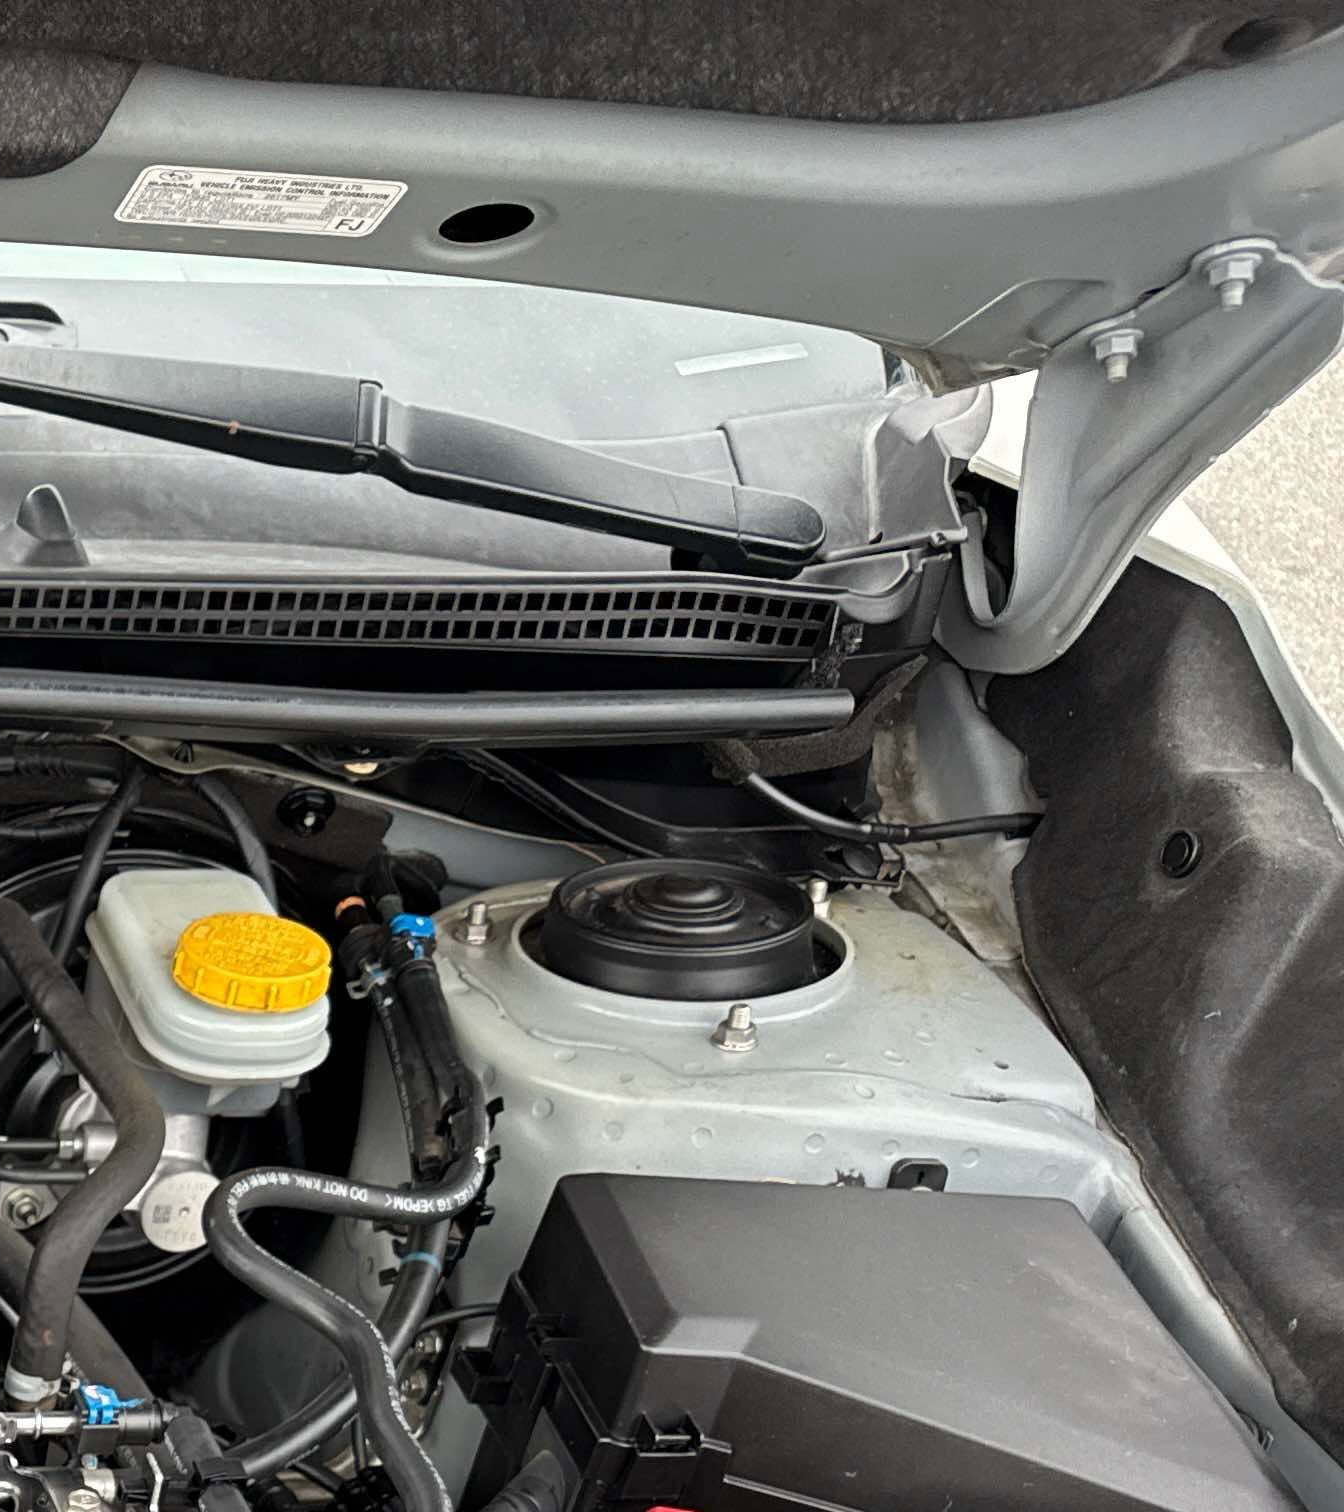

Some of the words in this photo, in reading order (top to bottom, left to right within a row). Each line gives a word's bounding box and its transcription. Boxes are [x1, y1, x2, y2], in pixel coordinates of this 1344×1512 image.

[235, 176, 256, 184] FUJI
[257, 177, 287, 186] HEAVY
[290, 180, 343, 190] INDUSTRIES
[201, 182, 236, 190] VEHICLE
[239, 185, 284, 193] EMISSION
[286, 187, 325, 197] CONTROL
[330, 190, 390, 201] INFORMATION
[335, 218, 365, 232] FJ
[323, 1181, 347, 1199] NOT
[350, 1187, 368, 1202] DO
